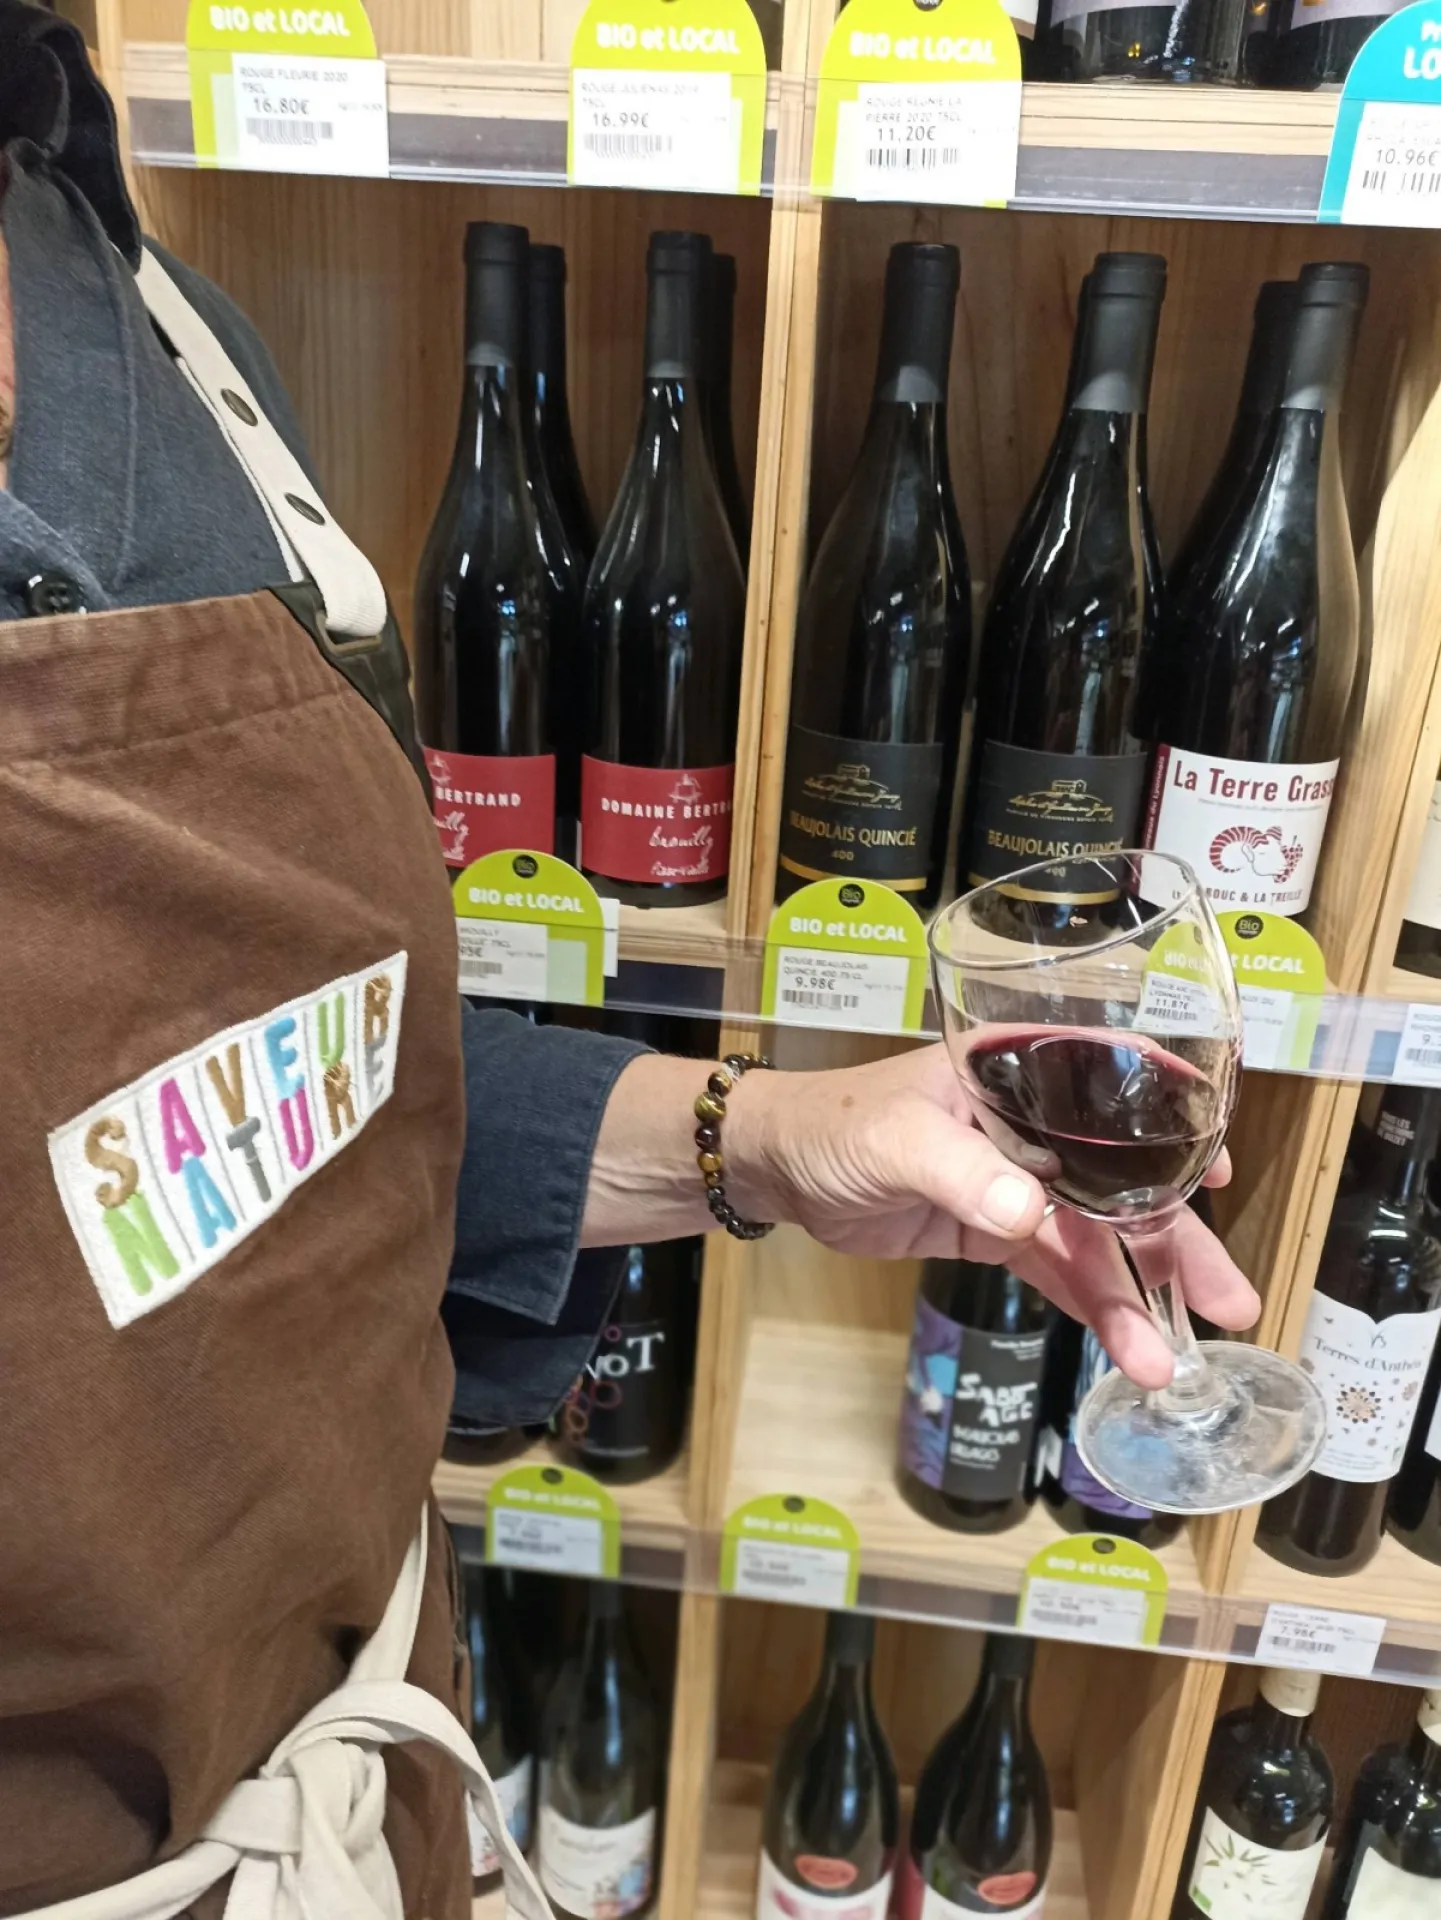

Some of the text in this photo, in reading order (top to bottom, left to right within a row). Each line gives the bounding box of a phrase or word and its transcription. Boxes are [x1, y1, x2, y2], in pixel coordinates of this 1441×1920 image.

[210, 7, 350, 37] BIO et LOCAL
[596, 22, 741, 55] BIO et LOCAL
[850, 31, 996, 65] BIO et LOCAL
[253, 98, 310, 116] 16.80€
[592, 111, 650, 129] 16.99€
[1376, 148, 1439, 166] 10.96€
[1173, 760, 1199, 792] La
[1208, 767, 1279, 802] Terre
[435, 786, 521, 807] BERTRAND
[601, 797, 735, 819] DOMAINE BERTR
[858, 826, 917, 848] QUINCIÉ
[987, 829, 1069, 858] BEAUJOLAIS
[468, 887, 585, 914] BIO et LOCAL
[1239, 889, 1251, 902] &
[1253, 890, 1268, 903] LA
[789, 917, 907, 943] BIO et LOCAL
[1239, 918, 1260, 931] Bio
[1242, 954, 1306, 974] LOCAL
[795, 976, 837, 991] 9.98€
[84, 972, 393, 1210] SAVEUR
[103, 1034, 389, 1297] NATURE
[1313, 1336, 1361, 1366] Terres
